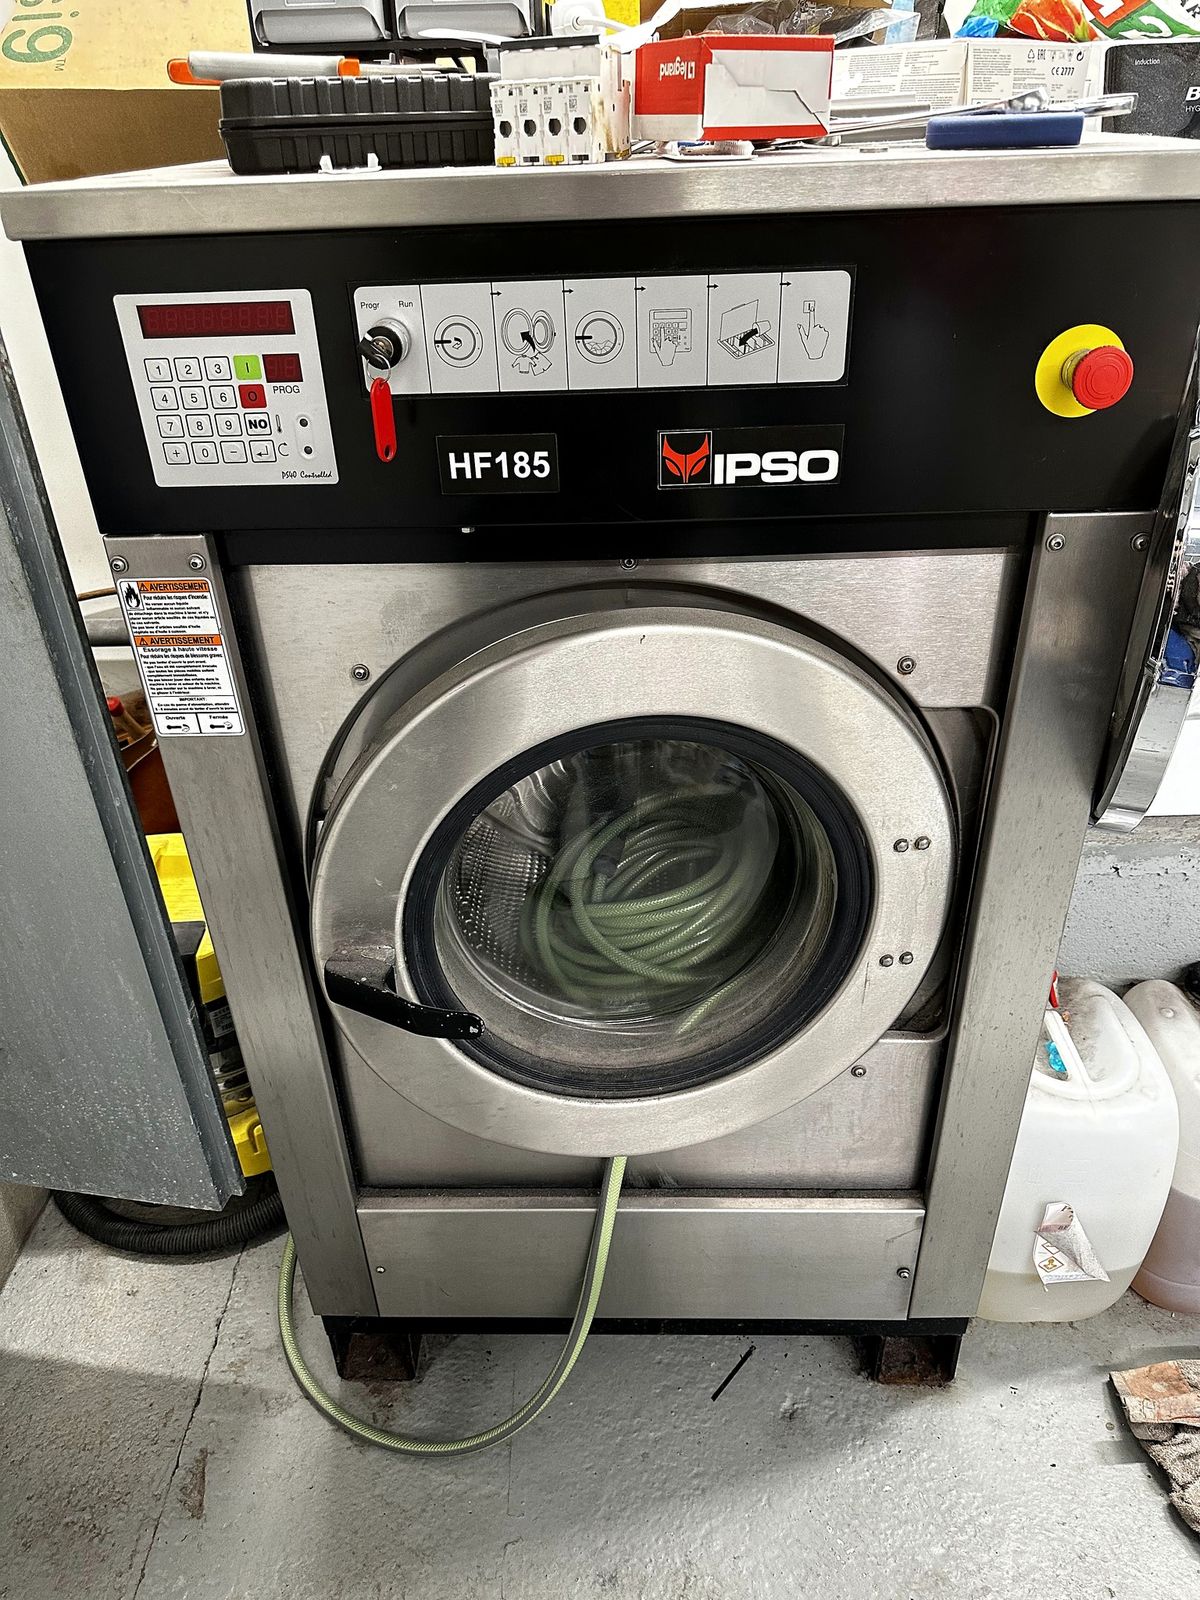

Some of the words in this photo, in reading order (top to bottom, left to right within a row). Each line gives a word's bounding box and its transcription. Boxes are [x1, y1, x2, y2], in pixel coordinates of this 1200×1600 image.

[360, 301, 380, 310] Progr
[398, 300, 414, 308] Run
[155, 366, 161, 375] 1
[184, 365, 192, 375] 2
[213, 364, 221, 374] 3
[272, 385, 300, 394] PROG
[161, 394, 168, 404] 4
[191, 393, 198, 403] 5
[220, 393, 227, 402] 6
[167, 421, 173, 431] 7
[197, 421, 203, 431] 8
[225, 420, 232, 430] 9
[248, 419, 267, 429] NO
[202, 448, 208, 458] 0
[448, 451, 551, 480] HF185
[714, 449, 839, 485] IPSO
[299, 470, 333, 479] Controlled
[149, 582, 208, 591] AVERTISSEMENT
[150, 636, 214, 645] AVERTISSEMENT
